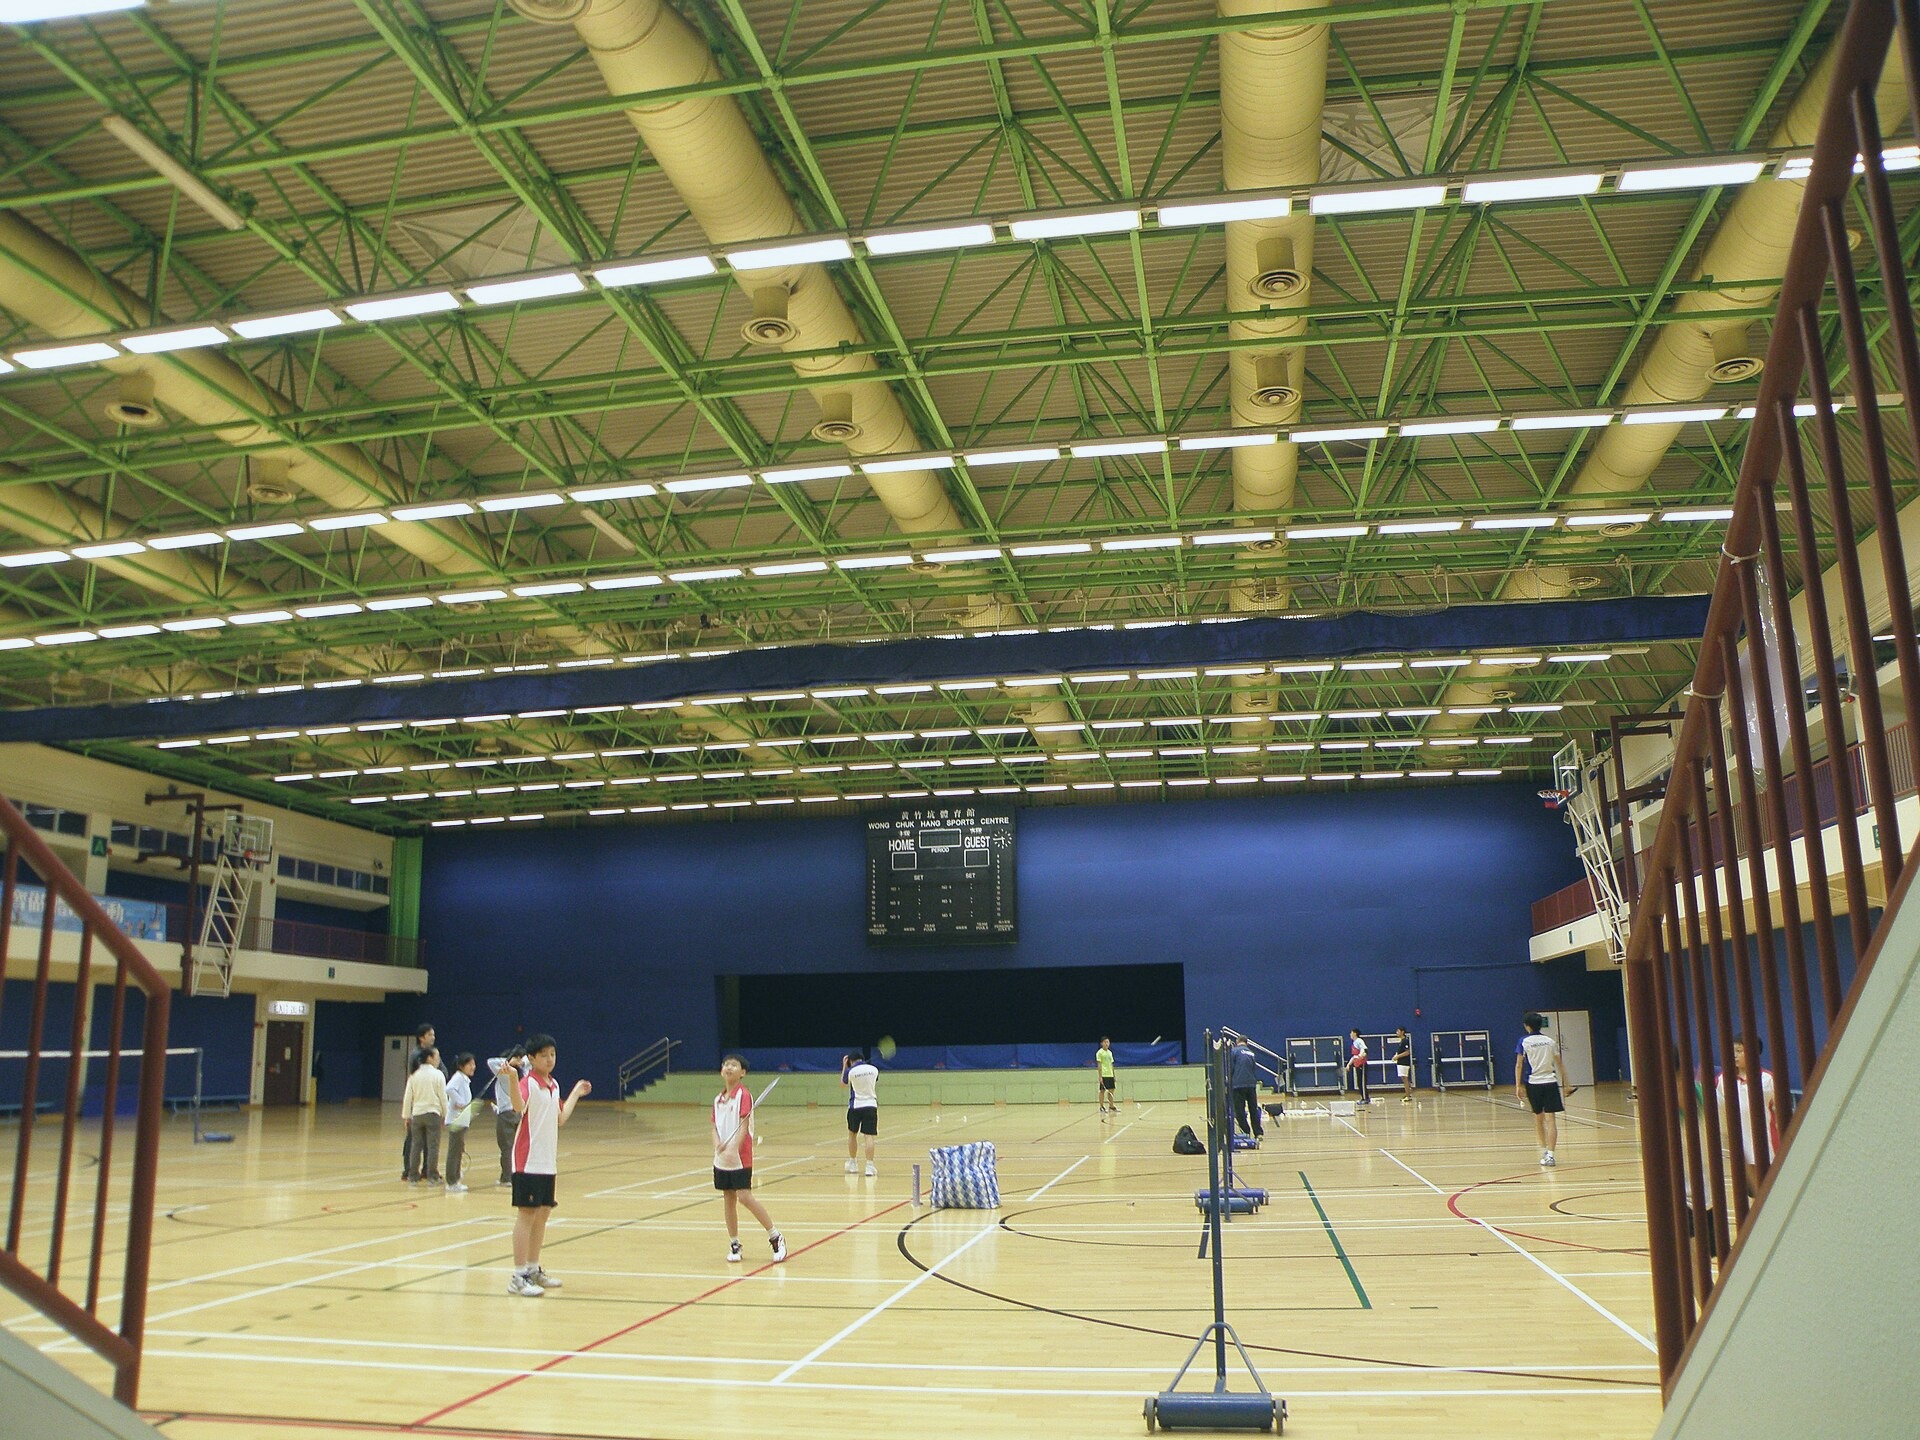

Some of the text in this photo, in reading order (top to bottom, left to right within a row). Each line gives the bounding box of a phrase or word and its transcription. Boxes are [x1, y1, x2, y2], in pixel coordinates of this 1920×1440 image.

[868, 822, 890, 830] WONG
[920, 819, 941, 828] HANG
[946, 818, 975, 827] SPORTS
[980, 817, 1009, 825] CENTRE
[888, 839, 915, 851] HOME
[964, 836, 990, 848] GUEST
